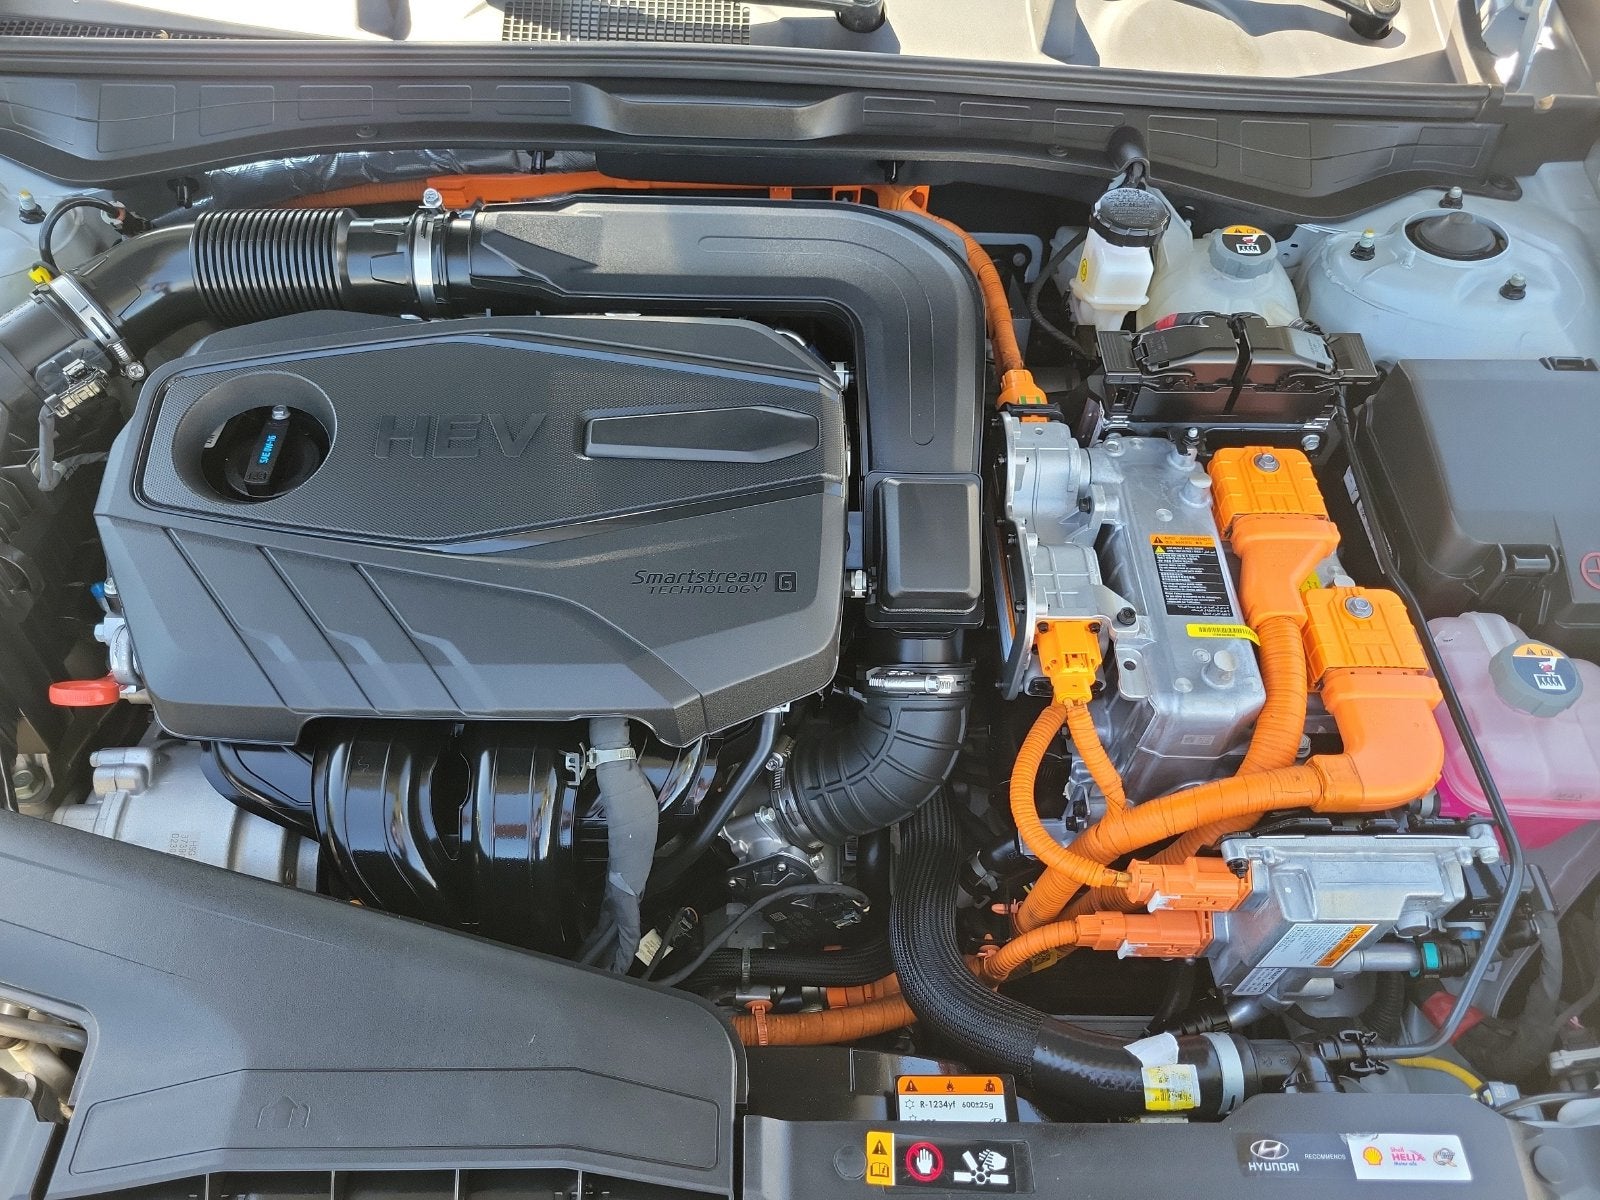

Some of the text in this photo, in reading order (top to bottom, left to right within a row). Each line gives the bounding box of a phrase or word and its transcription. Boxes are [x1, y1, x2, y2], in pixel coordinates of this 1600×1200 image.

[374, 413, 547, 459] HEV
[631, 569, 768, 585] Smartstream
[649, 585, 764, 595] TECHNOLOGY
[920, 1100, 994, 1110] R-1234yf 600±25g
[1391, 1152, 1425, 1162] HELIX
[1248, 1161, 1300, 1172] HYUNDAI
